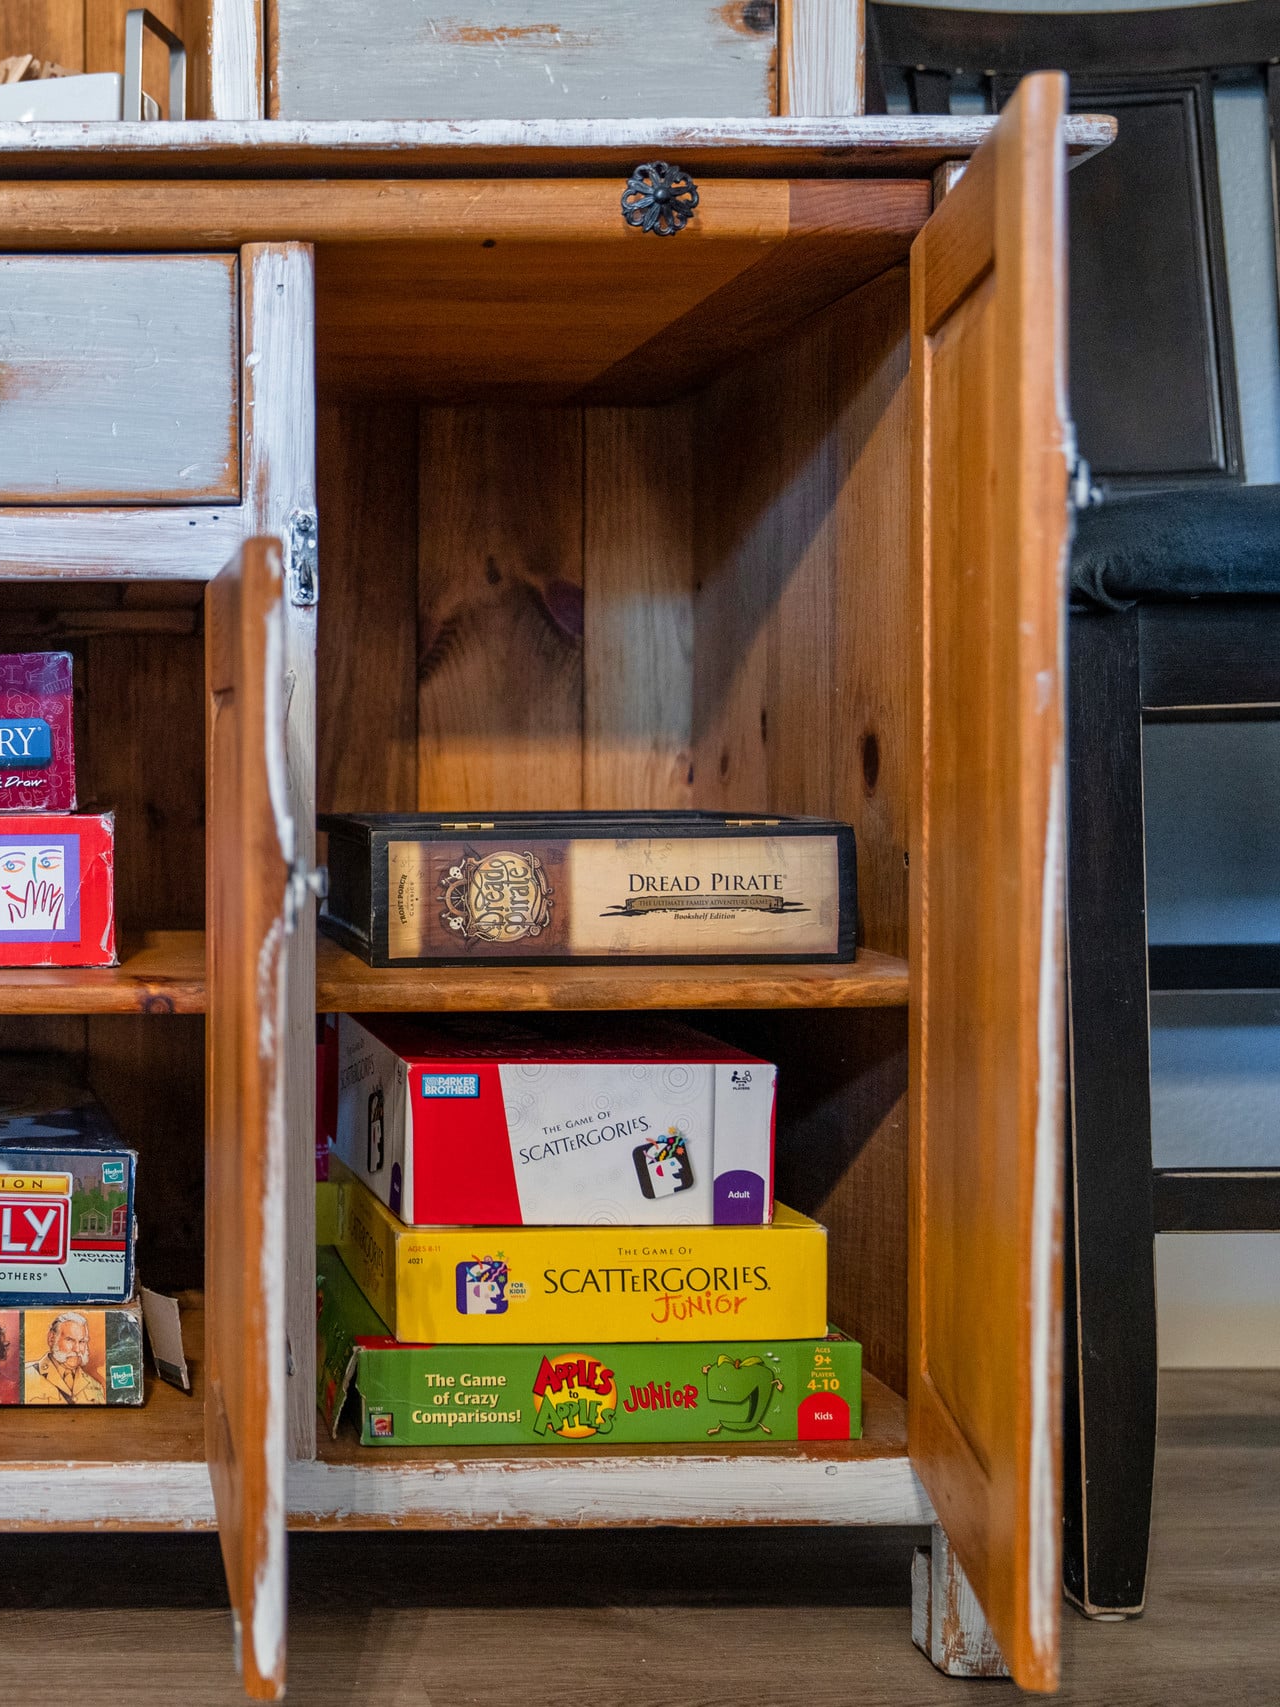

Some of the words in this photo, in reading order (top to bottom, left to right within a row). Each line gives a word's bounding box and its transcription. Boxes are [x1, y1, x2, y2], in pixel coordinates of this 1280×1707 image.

[5, 775, 43, 789] Draw
[397, 873, 408, 899] PORCH
[629, 874, 701, 892] DREAD
[710, 872, 784, 891] PIRATE
[397, 899, 408, 925] FRONT
[673, 912, 709, 921] Bookshelf
[709, 912, 736, 920] Edition
[438, 1076, 476, 1086] PARKER
[424, 1085, 476, 1095] BROTHERS
[542, 1124, 562, 1136] THE
[565, 1116, 593, 1129] GAME
[597, 1111, 612, 1120] OF
[727, 1190, 751, 1199] Adult
[617, 1247, 638, 1256] THE
[642, 1246, 674, 1256] GAME
[678, 1246, 693, 1255] OF
[814, 1354, 832, 1366] 9+
[425, 1373, 456, 1387] The
[459, 1373, 507, 1387] Game
[532, 1355, 615, 1397] APPLES
[806, 1378, 840, 1391] 4-10
[433, 1391, 451, 1405] of
[454, 1391, 499, 1408] Crazy
[568, 1390, 579, 1399] to
[411, 1409, 522, 1427] Comparisons!
[533, 1394, 617, 1437] APPLES
[814, 1411, 833, 1421] Kids
